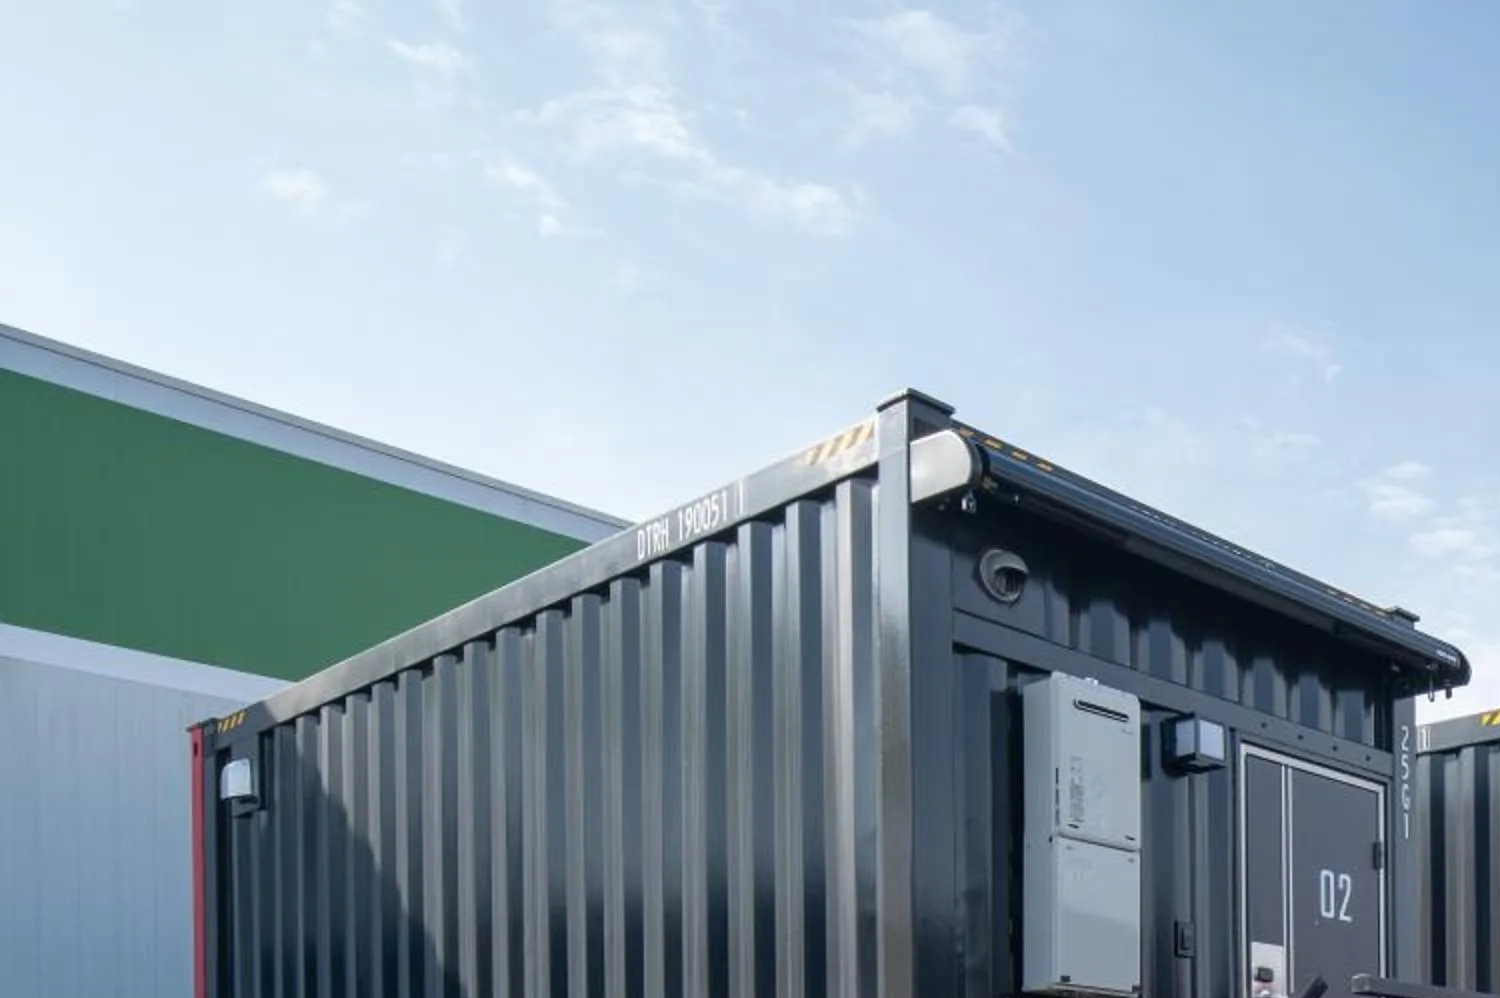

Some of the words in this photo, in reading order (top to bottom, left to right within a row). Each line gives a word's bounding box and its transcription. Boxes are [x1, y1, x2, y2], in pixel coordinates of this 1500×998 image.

[637, 518, 669, 561] DTRH
[678, 489, 728, 542] 190051
[1320, 869, 1352, 922] 02
